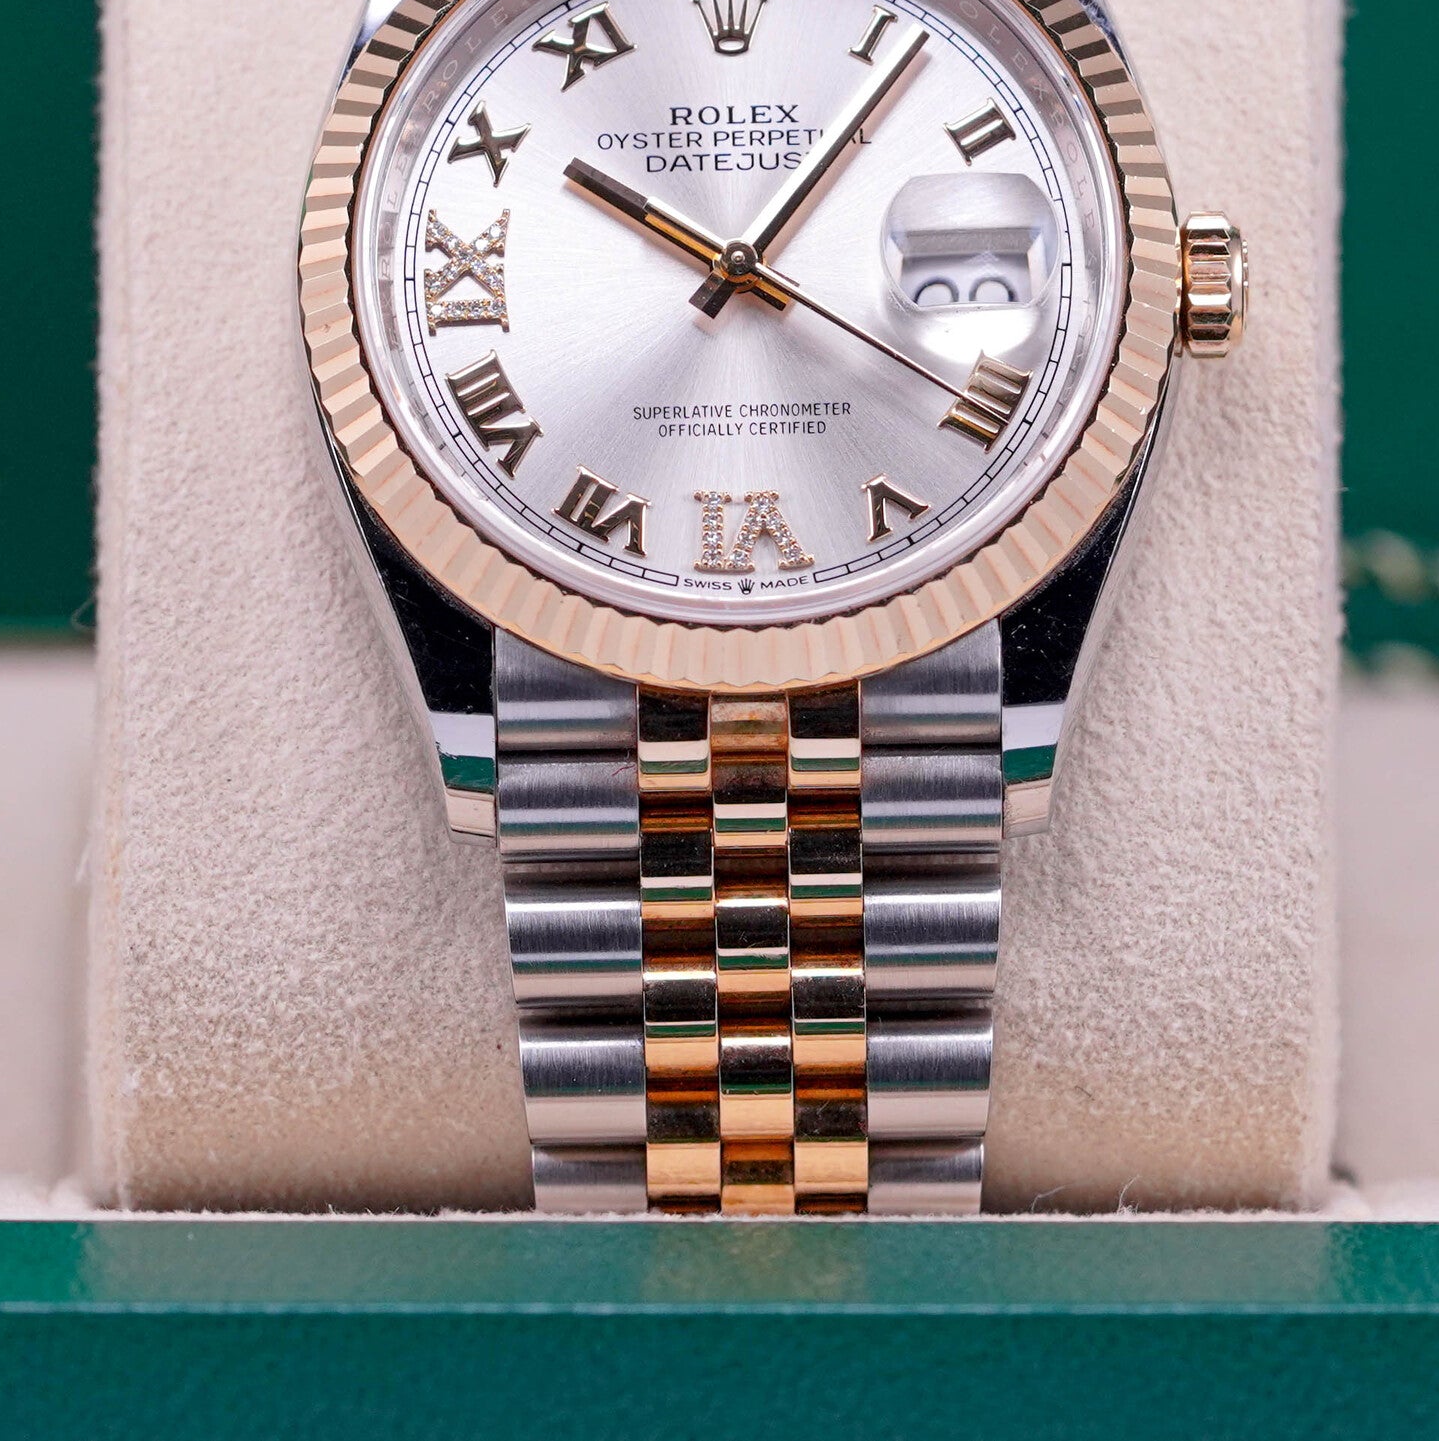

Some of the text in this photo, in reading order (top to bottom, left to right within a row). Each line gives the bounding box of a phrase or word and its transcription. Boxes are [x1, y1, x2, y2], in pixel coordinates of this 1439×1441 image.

[668, 104, 800, 126] ROLEX
[596, 128, 873, 151] OYSTER PERPETL
[646, 152, 809, 173] DATEJUS
[632, 402, 852, 420] SUPERLATIVE CHRONOMETER
[658, 421, 827, 438] OFFICIALLY CERTIFIED
[683, 575, 809, 591] SWISS MADE
